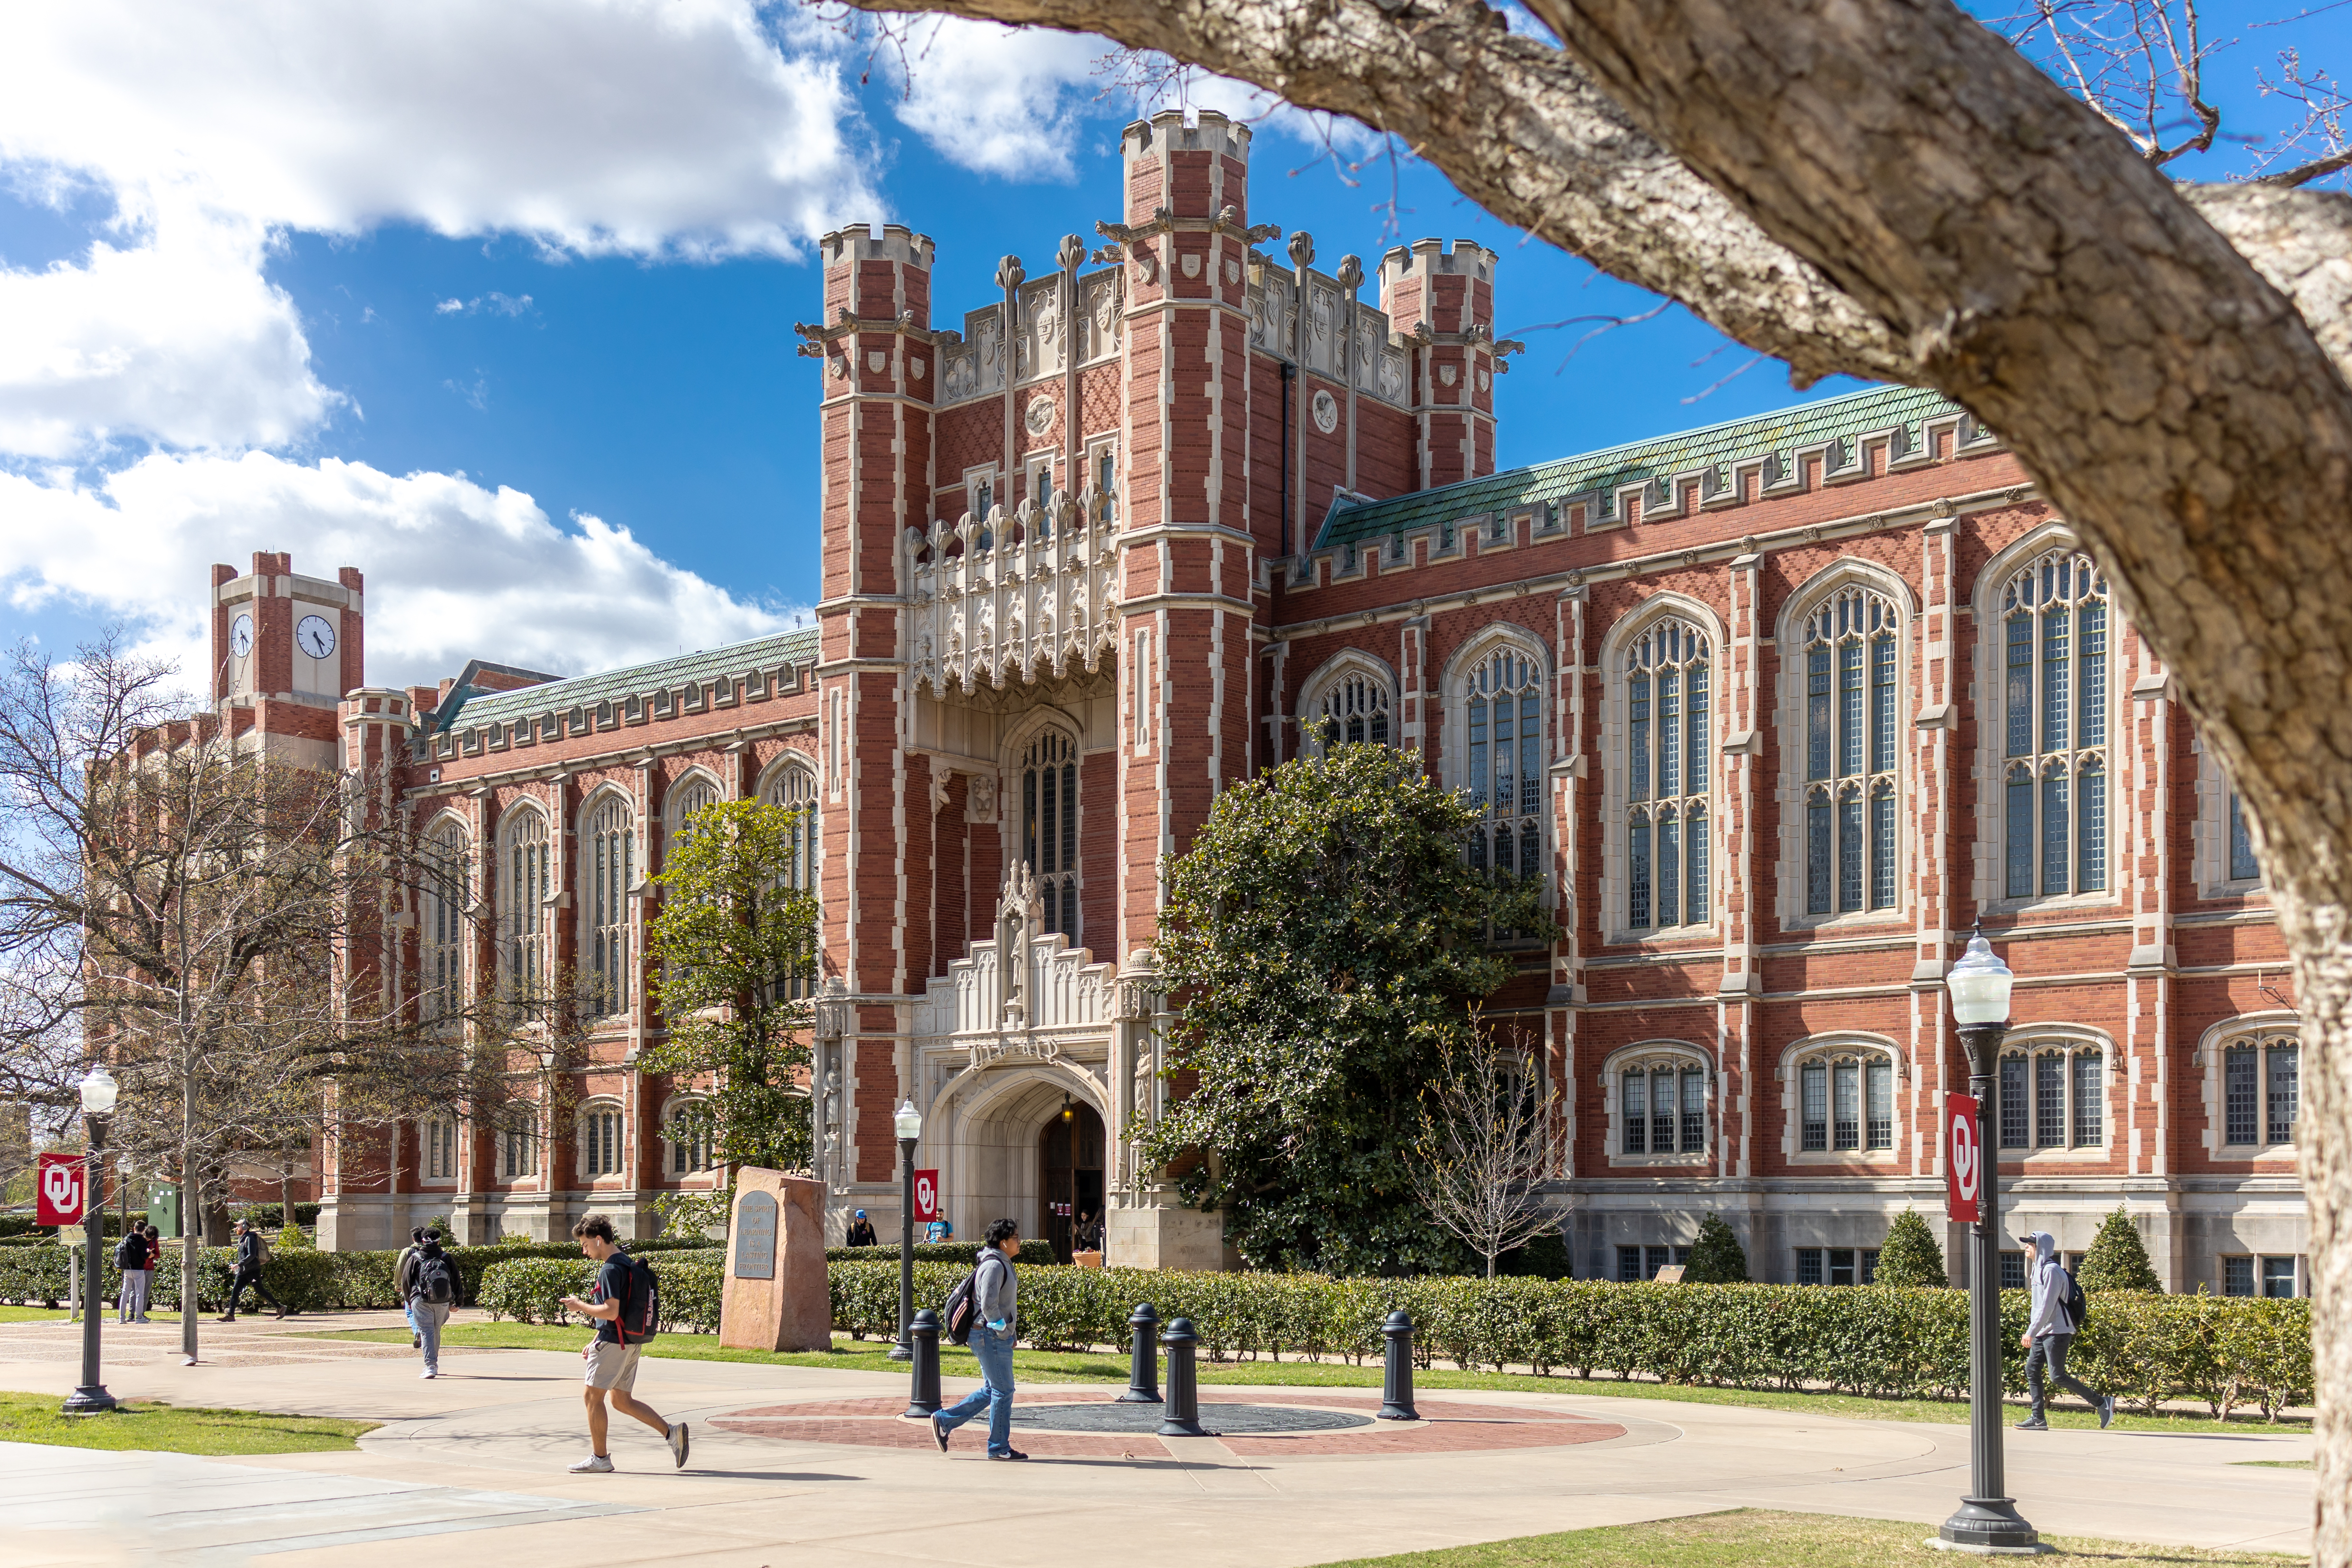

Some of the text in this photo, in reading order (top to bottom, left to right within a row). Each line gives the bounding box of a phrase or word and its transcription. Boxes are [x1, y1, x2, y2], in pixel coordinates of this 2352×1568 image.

[1952, 1114, 1978, 1201] OU
[44, 1164, 79, 1214] OU
[917, 1177, 935, 1214] OU
[739, 1262, 769, 1271] FRONTIER
